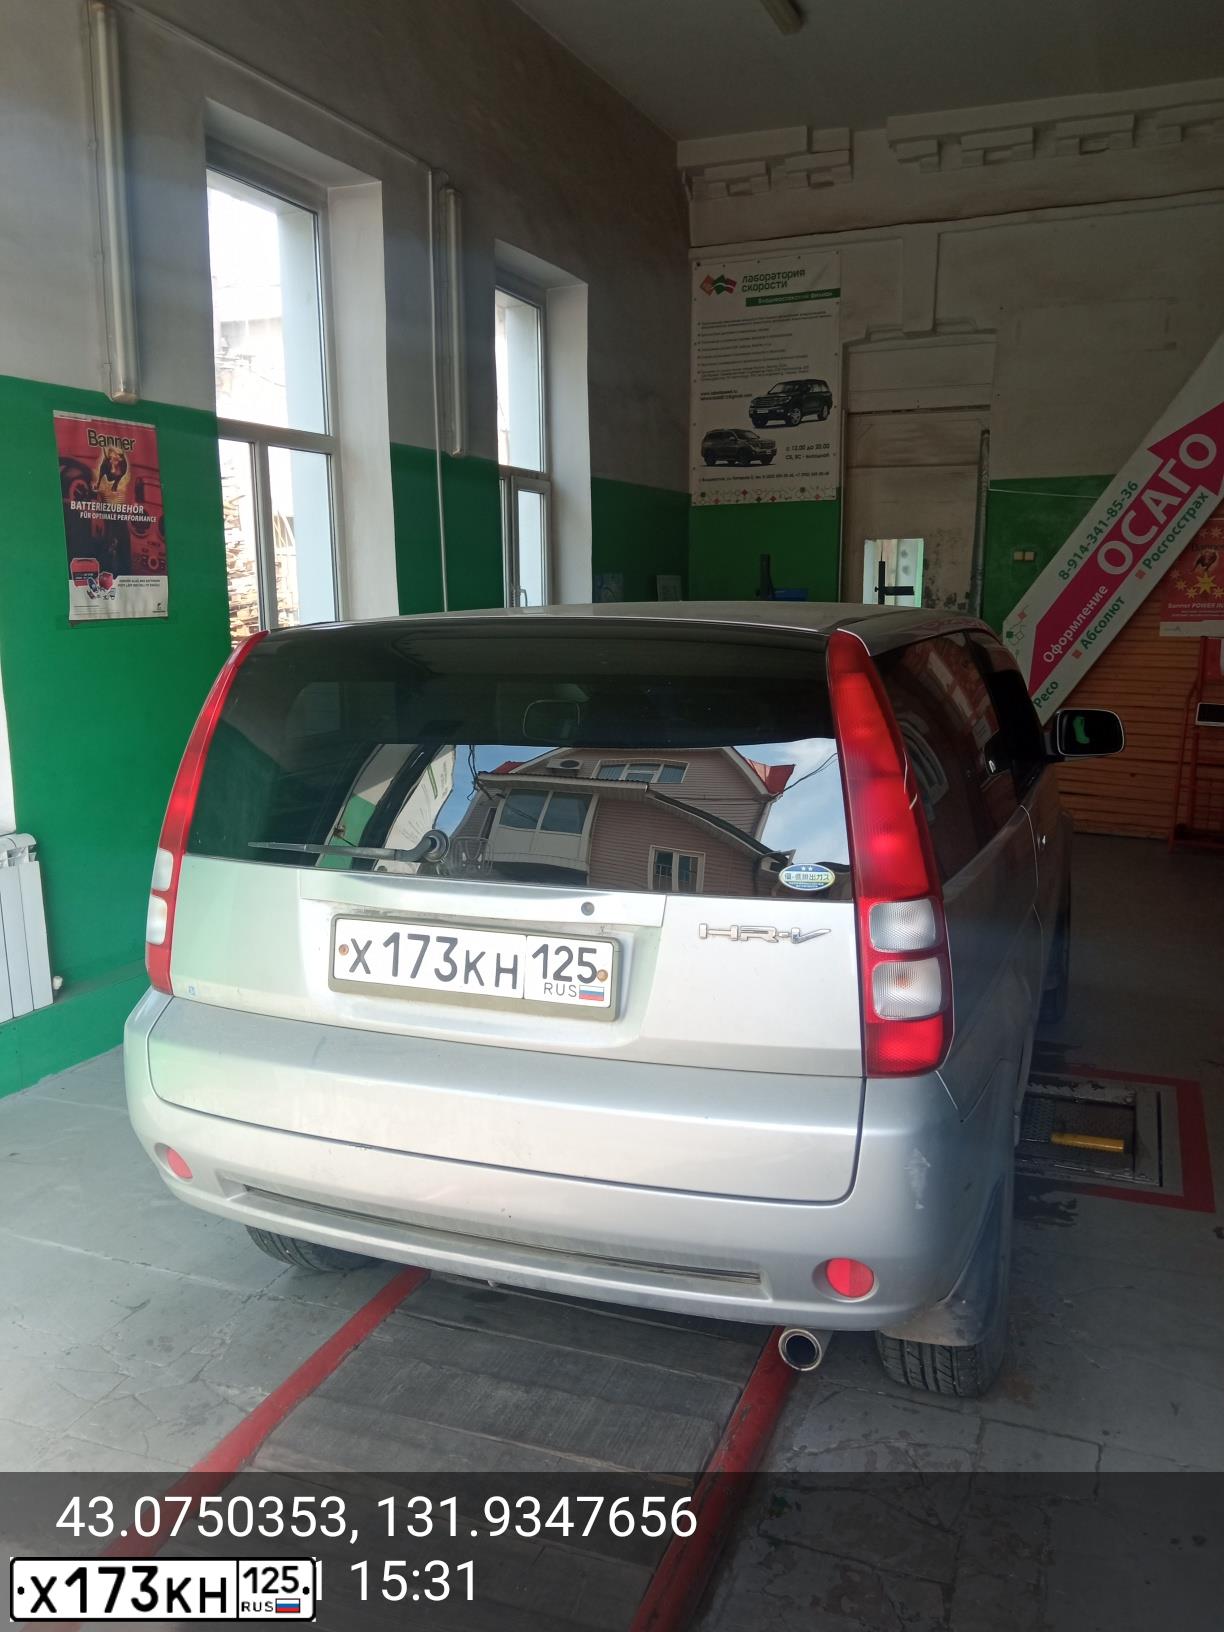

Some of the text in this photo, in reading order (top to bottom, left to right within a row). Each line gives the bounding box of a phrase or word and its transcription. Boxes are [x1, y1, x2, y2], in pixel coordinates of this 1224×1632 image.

[742, 269, 806, 284] лаборатория
[742, 280, 788, 293] скорости
[87, 428, 135, 451] Banner
[1097, 433, 1217, 575] ОСАГО
[1058, 480, 1139, 581] 8-914-341-85-36
[1142, 491, 1209, 569] Росгосстрах
[1043, 584, 1109, 663] Оформление
[1080, 596, 1126, 650] Абсолют
[1033, 680, 1059, 709] Ресо
[698, 922, 831, 944] HR-V
[531, 943, 598, 984] 125
[543, 981, 577, 998] RUS
